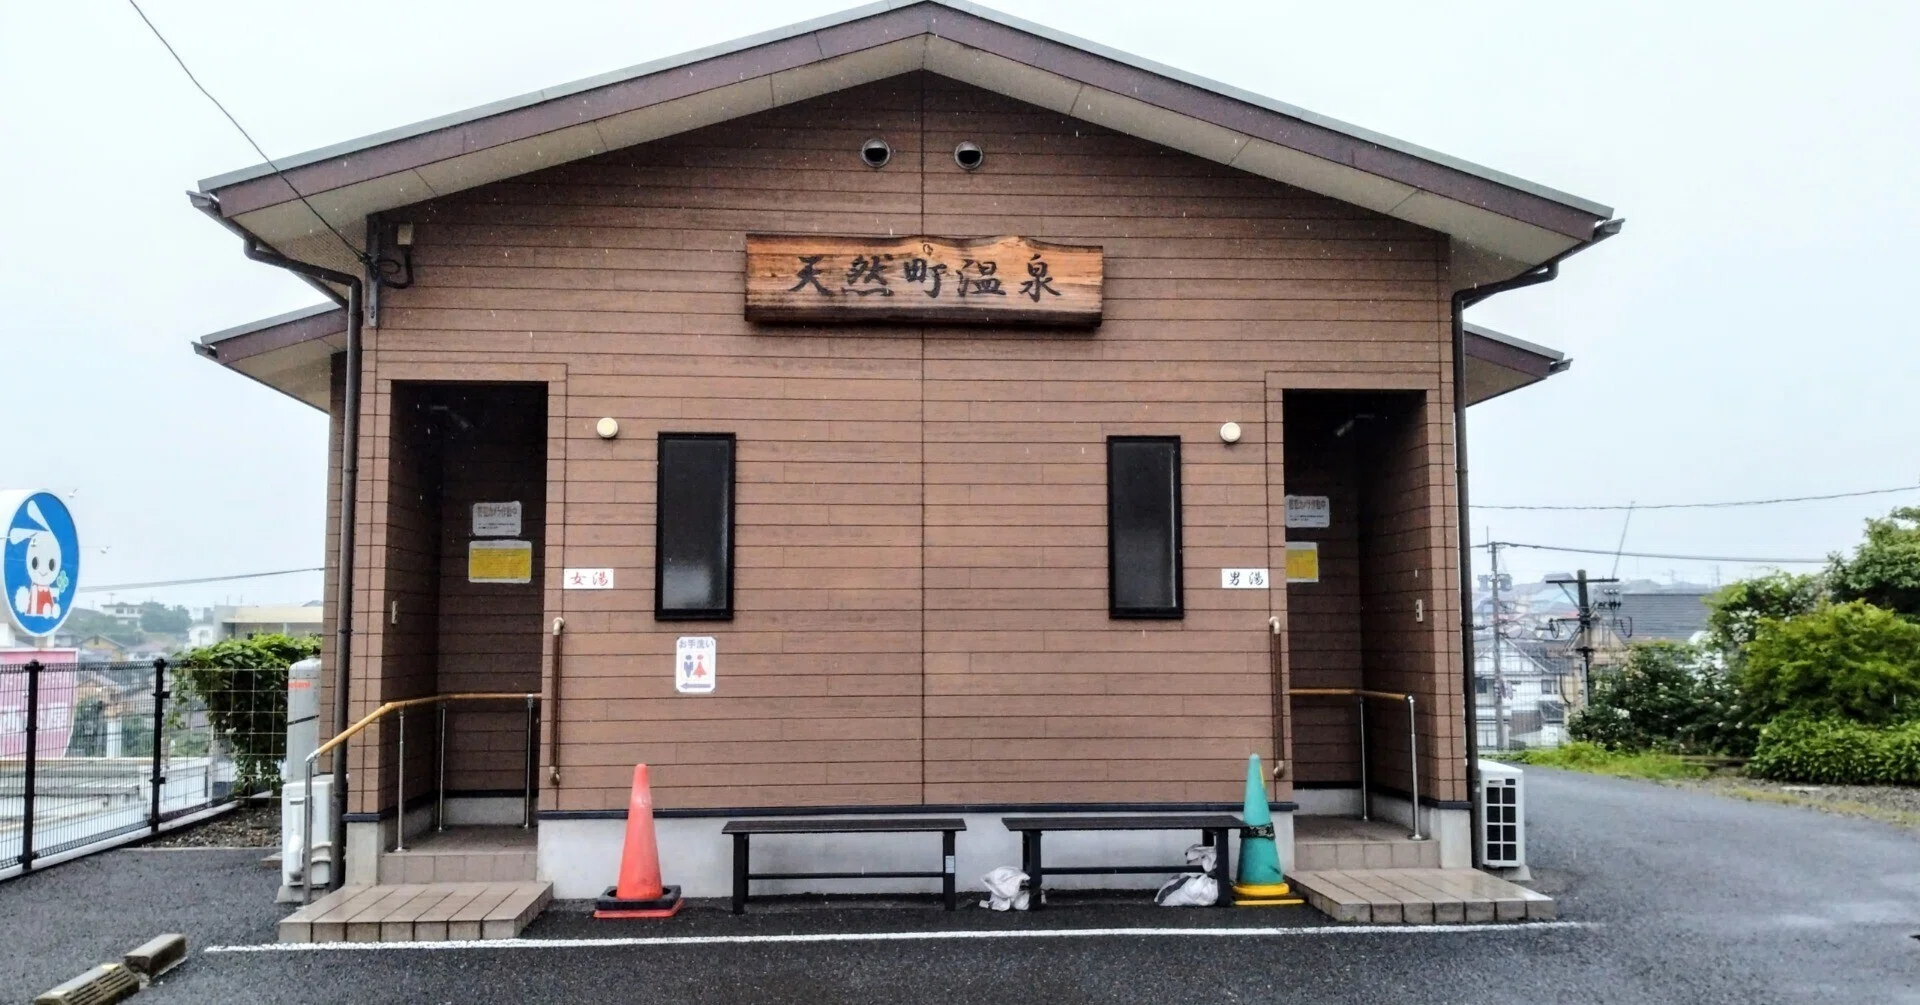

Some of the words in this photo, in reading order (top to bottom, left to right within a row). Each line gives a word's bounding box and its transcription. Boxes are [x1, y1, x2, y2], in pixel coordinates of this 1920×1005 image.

[788, 254, 1062, 302] 天然町温泉
[570, 571, 608, 586] 女湯
[1229, 571, 1263, 585] 男湯
[678, 638, 715, 649] お手洗い
